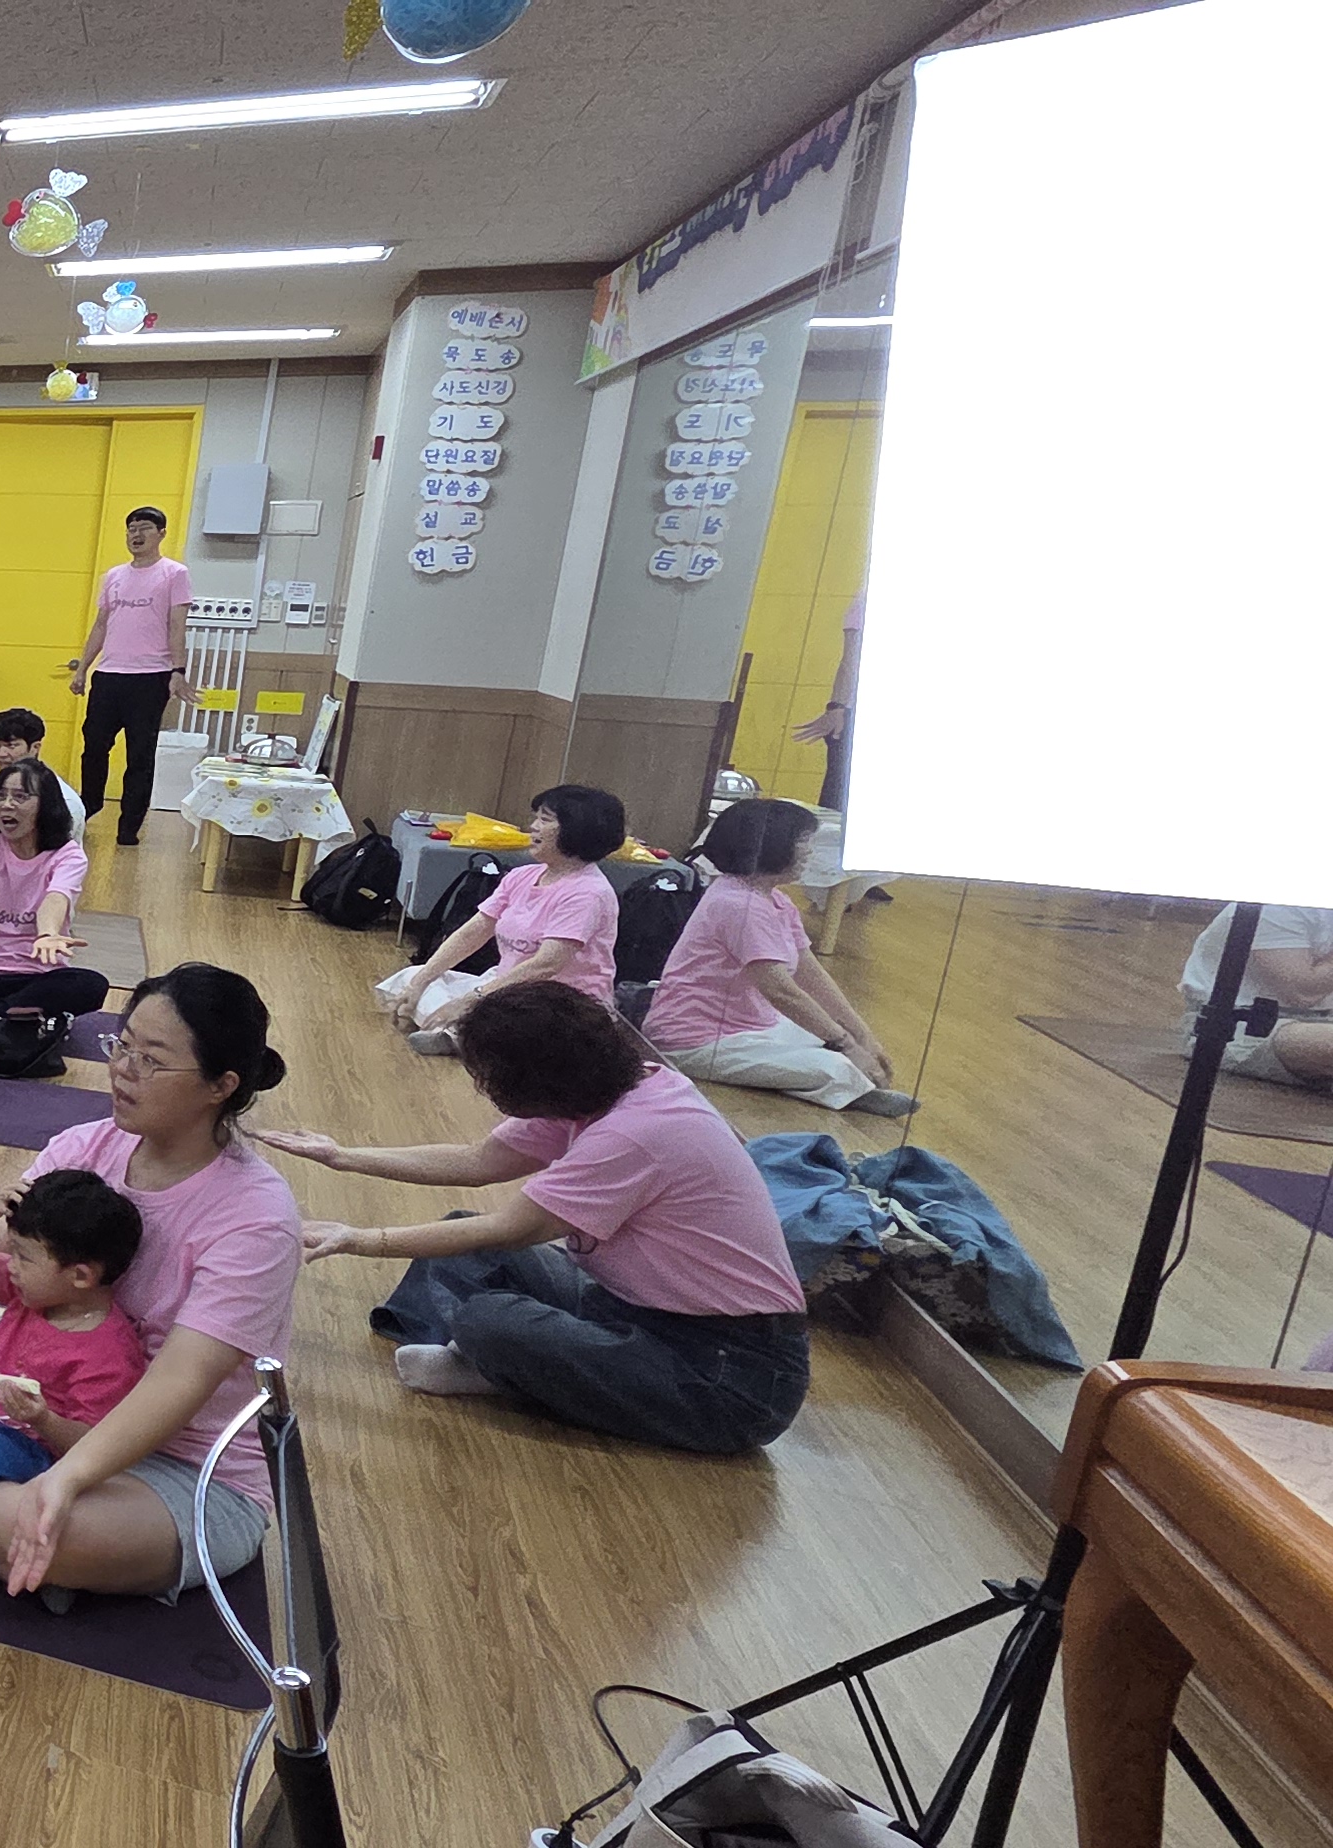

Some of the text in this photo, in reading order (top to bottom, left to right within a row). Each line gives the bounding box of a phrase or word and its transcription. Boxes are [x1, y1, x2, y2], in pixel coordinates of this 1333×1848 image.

[450, 308, 524, 332] 예배순서
[438, 380, 509, 396] 사도신경
[424, 448, 497, 466] 단원요절
[426, 479, 482, 498] 말씀송
